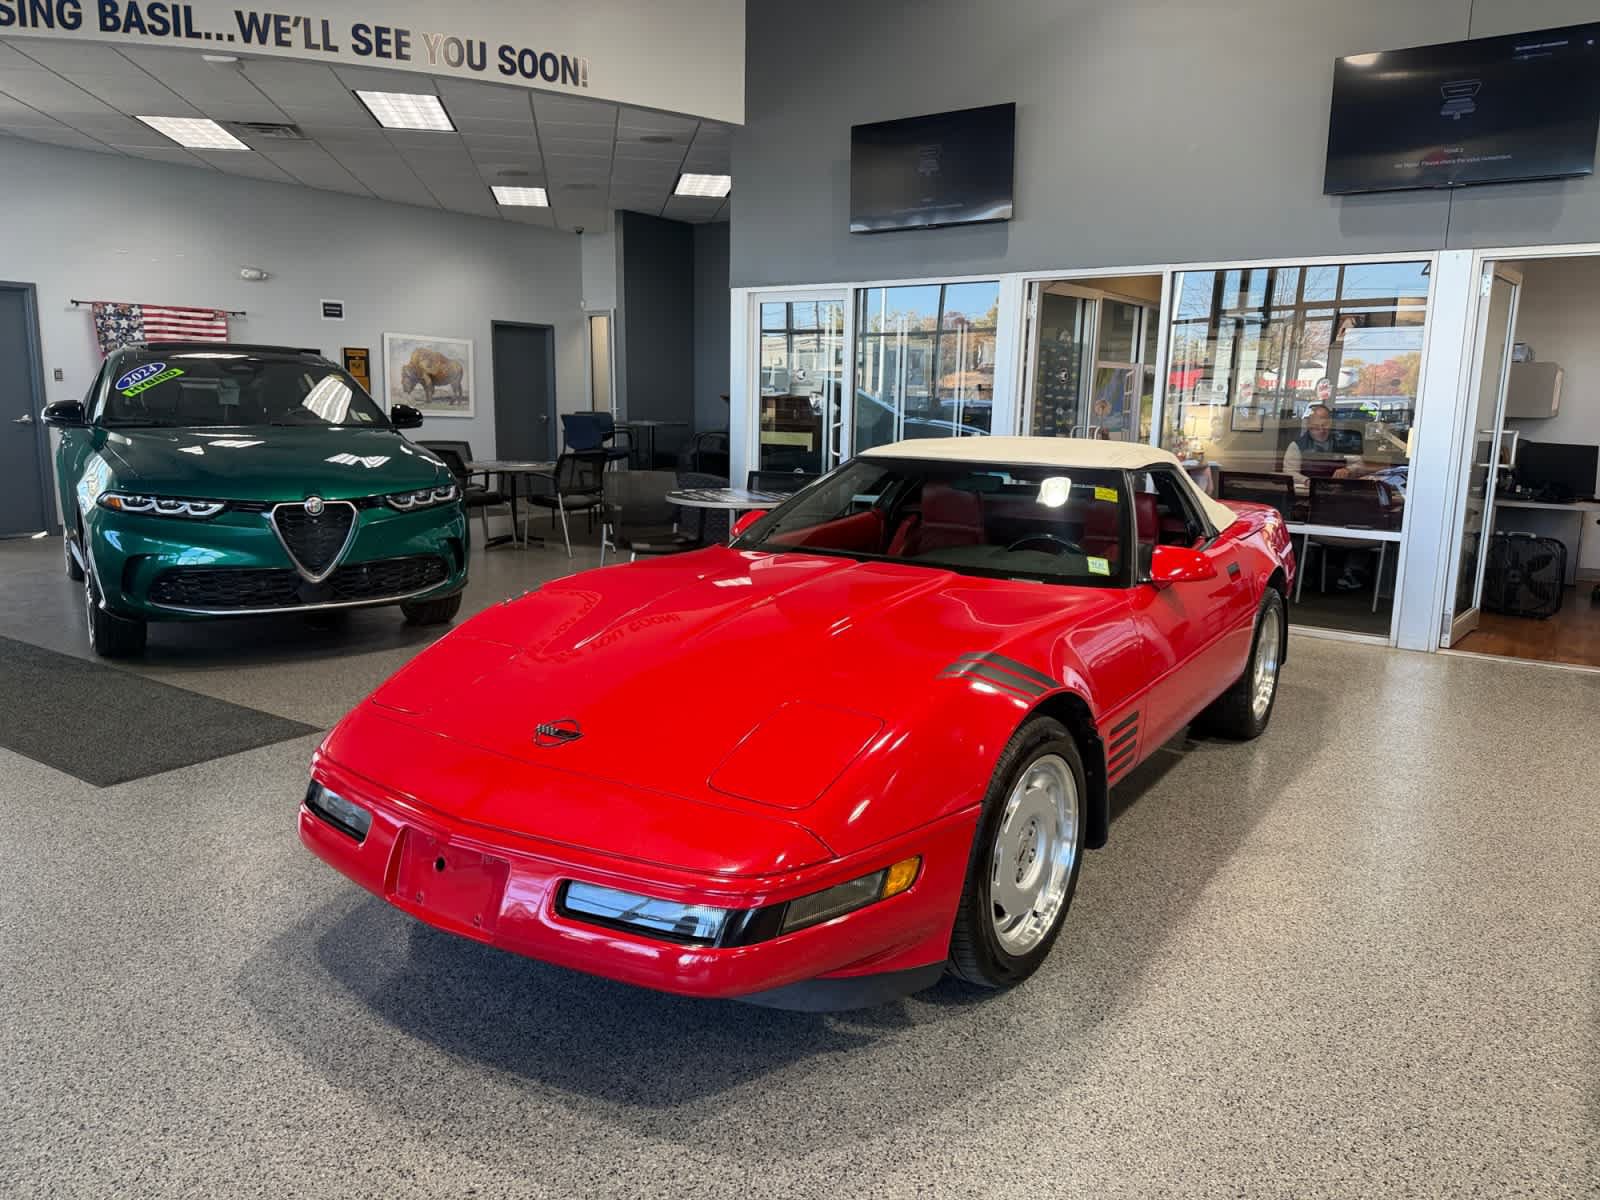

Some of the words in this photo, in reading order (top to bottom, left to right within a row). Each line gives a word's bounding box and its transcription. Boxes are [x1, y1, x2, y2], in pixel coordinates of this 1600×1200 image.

[351, 23, 411, 61] SEE
[422, 31, 487, 71] YOU
[497, 44, 589, 88] SOON!
[124, 364, 158, 385] 2024
